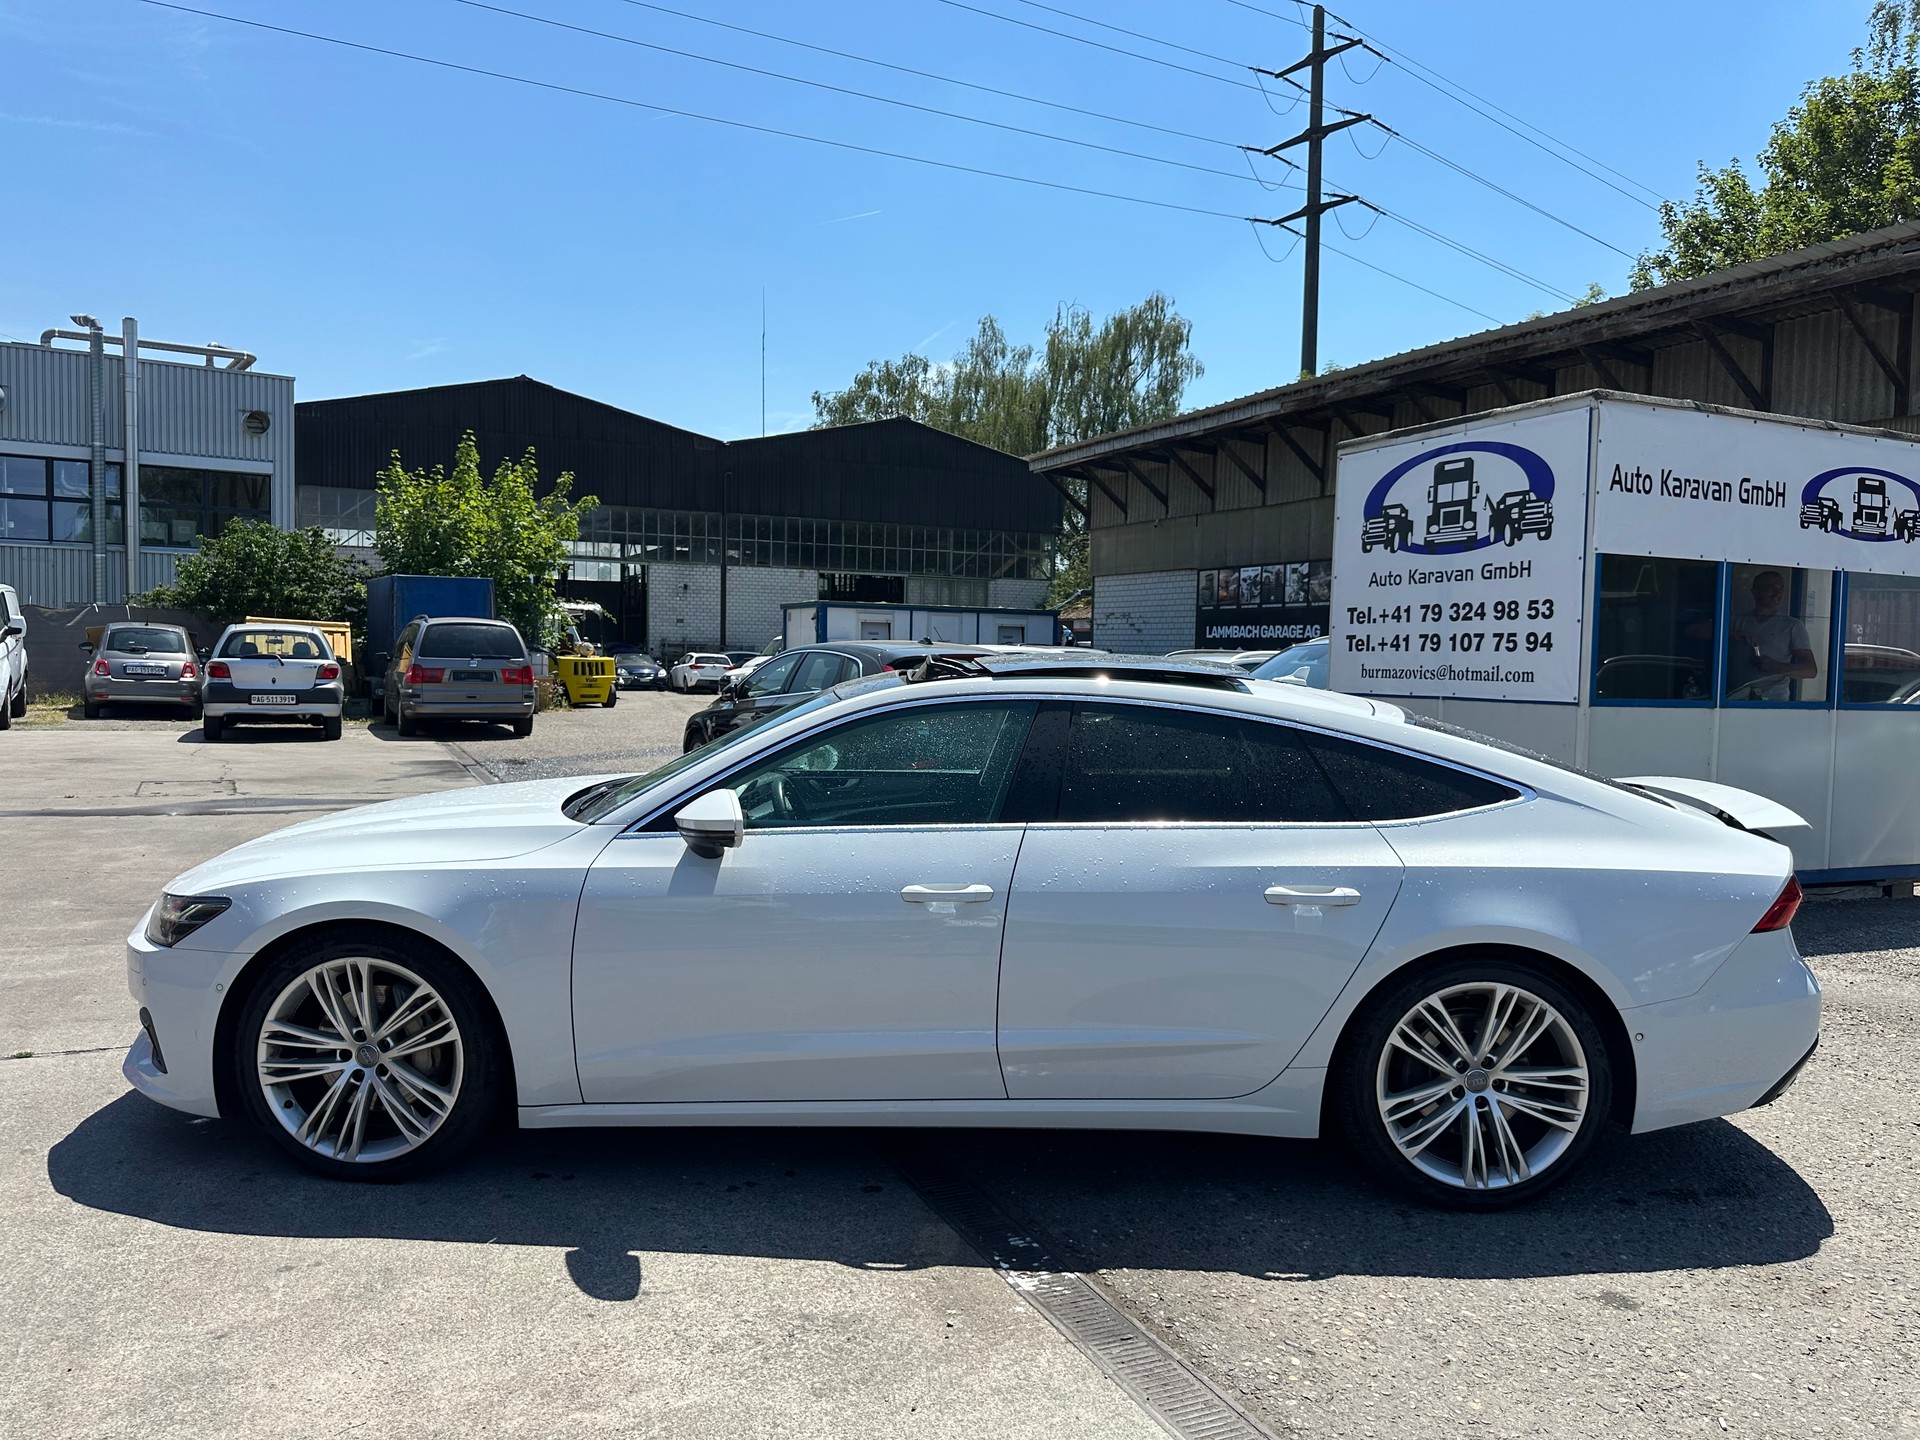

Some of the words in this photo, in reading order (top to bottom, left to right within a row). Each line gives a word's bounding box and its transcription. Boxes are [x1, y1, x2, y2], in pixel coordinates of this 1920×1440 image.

[1609, 463, 1653, 495] Auto
[1660, 468, 1732, 503] Karavan
[1738, 477, 1787, 508] GmbH
[1368, 571, 1402, 588] Auto
[1408, 566, 1474, 585] Karavan
[1481, 560, 1532, 580] GmbH
[1420, 603, 1442, 623] 79
[1449, 602, 1486, 621] 324
[1493, 600, 1519, 620] 98
[1527, 598, 1554, 620] 53
[1206, 625, 1259, 638] LAMMBACH
[1260, 624, 1304, 638] GARAGE
[1304, 624, 1321, 638] AG
[1419, 633, 1441, 652] 79
[1449, 633, 1485, 652] 107
[1492, 632, 1518, 652] 75
[1525, 631, 1553, 652] 94
[1360, 664, 1535, 684] burmazovics@hotmail.com
